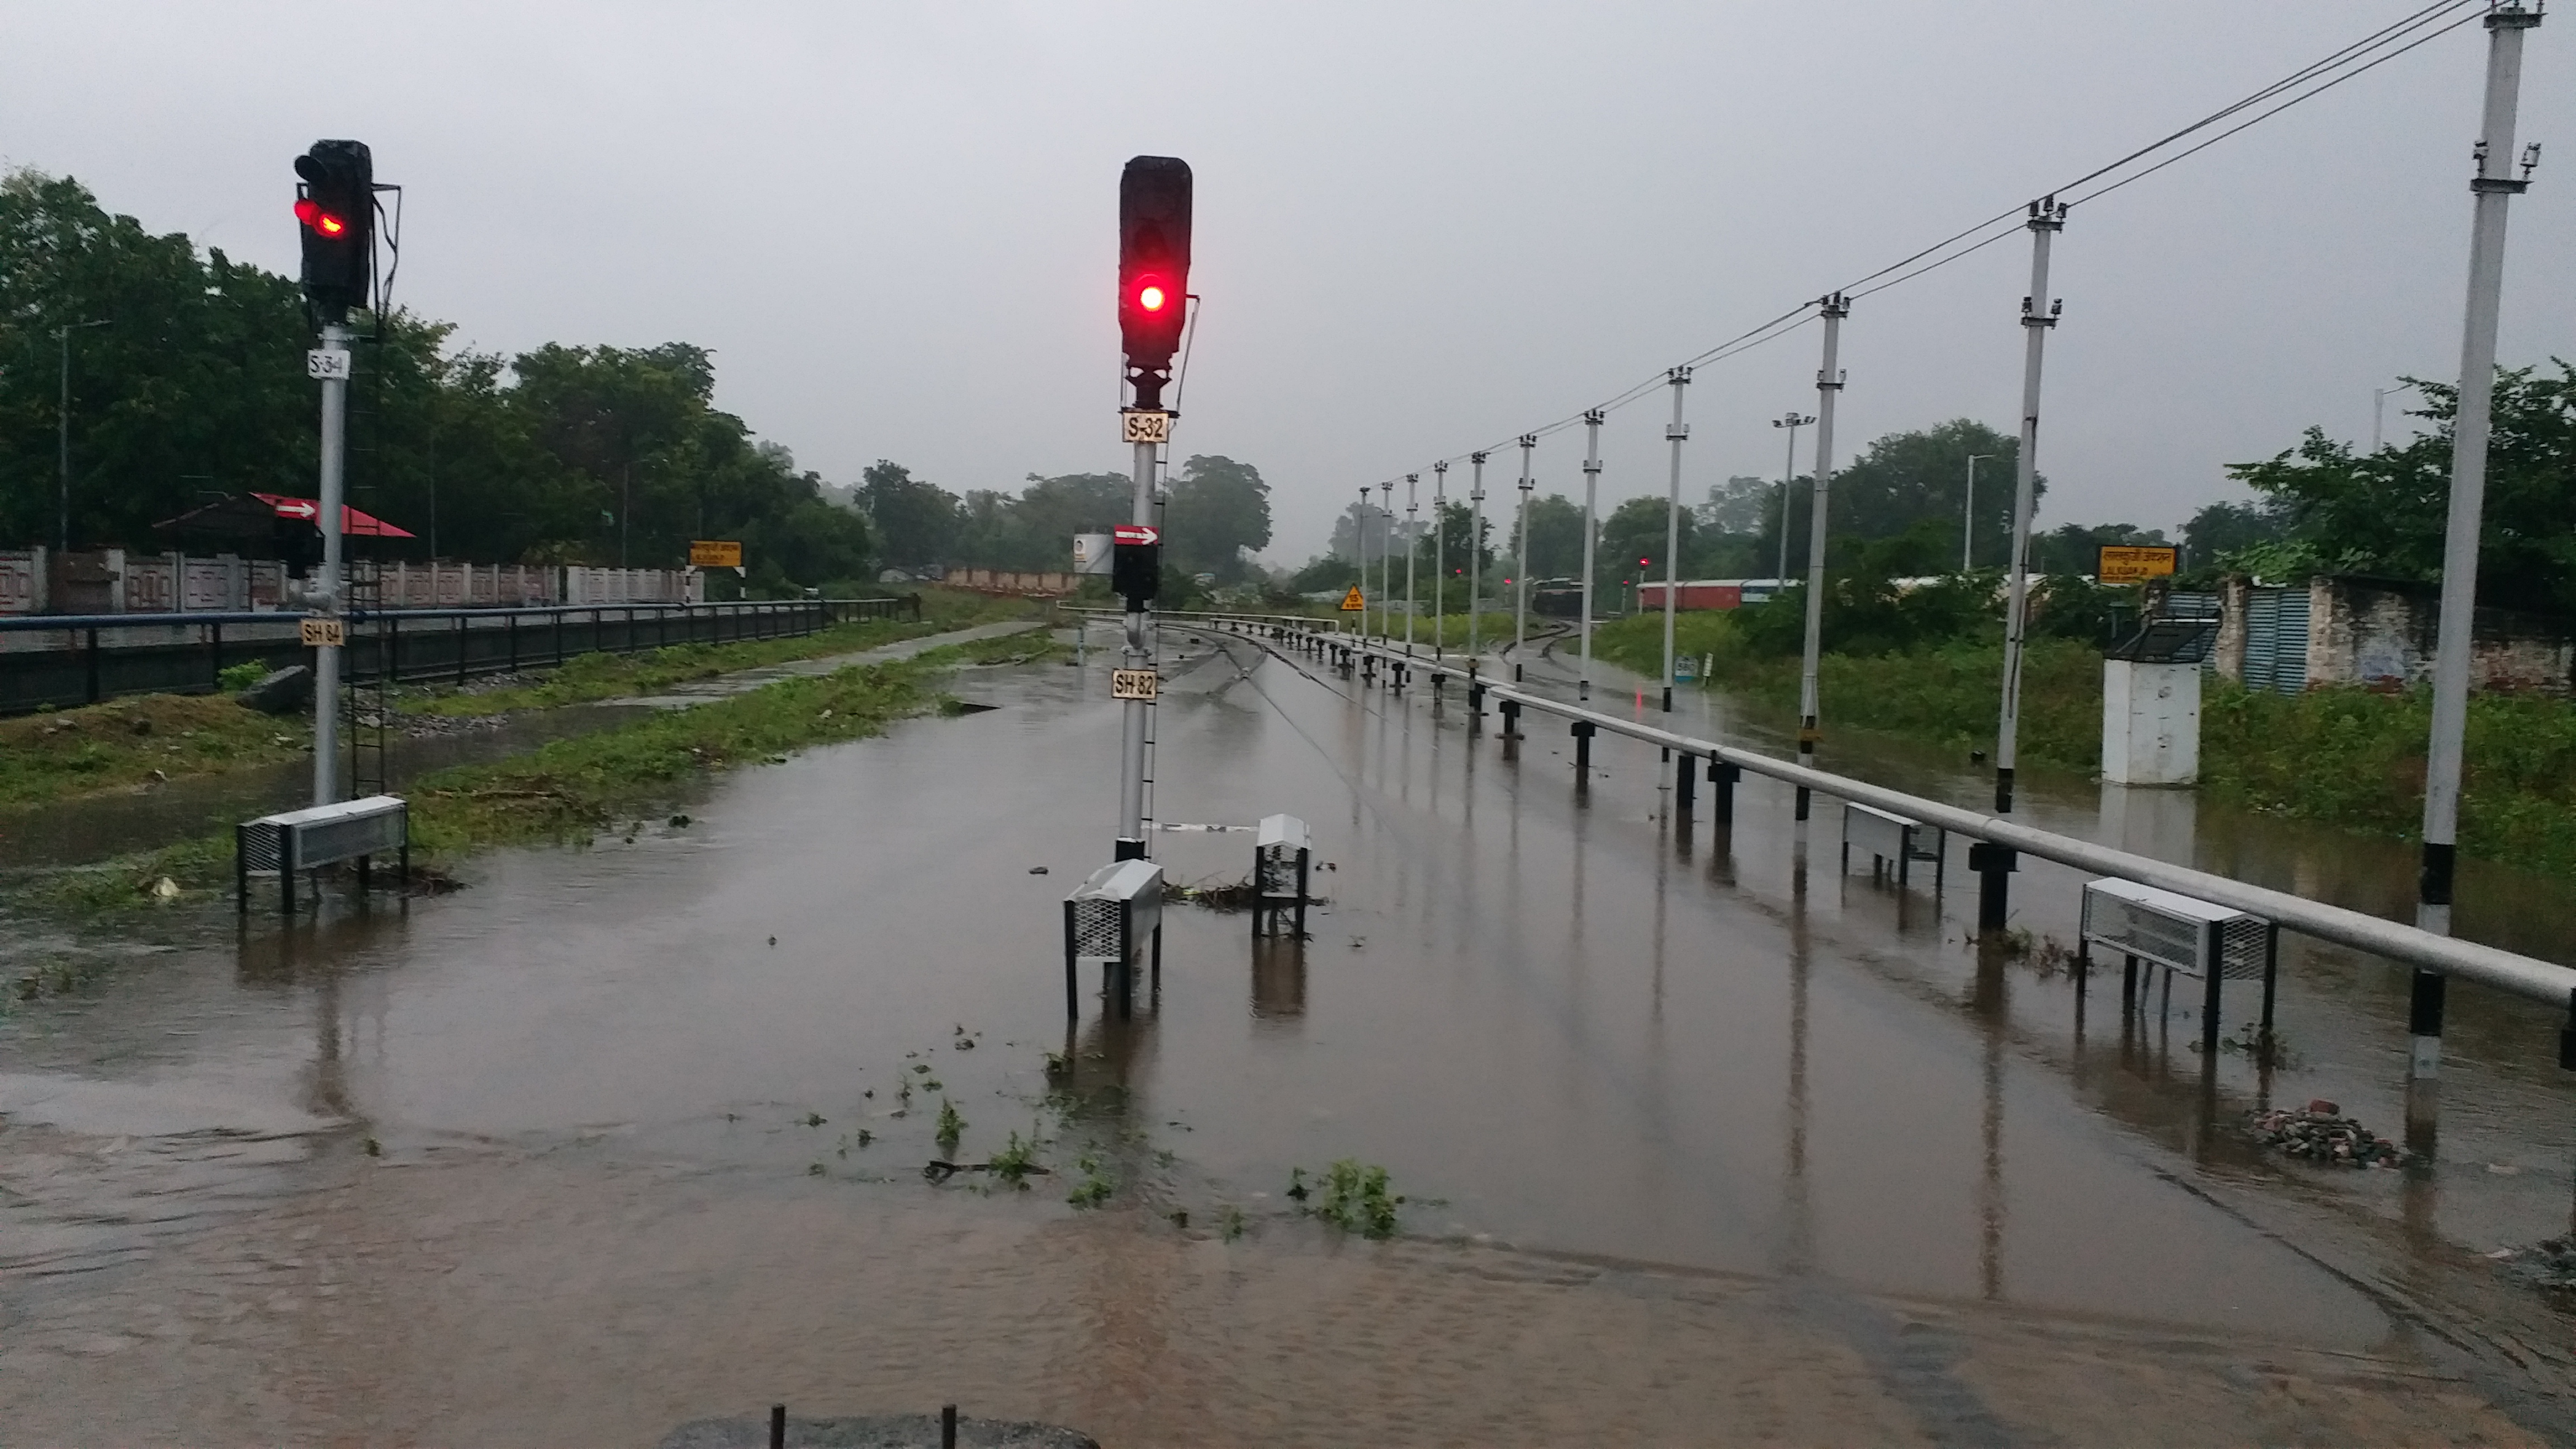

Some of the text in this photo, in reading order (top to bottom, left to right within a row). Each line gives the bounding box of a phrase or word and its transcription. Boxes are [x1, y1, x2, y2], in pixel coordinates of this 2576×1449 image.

[1128, 417, 1163, 438] S-32
[305, 624, 339, 642] SH 84
[1116, 674, 1153, 695] SH 82
